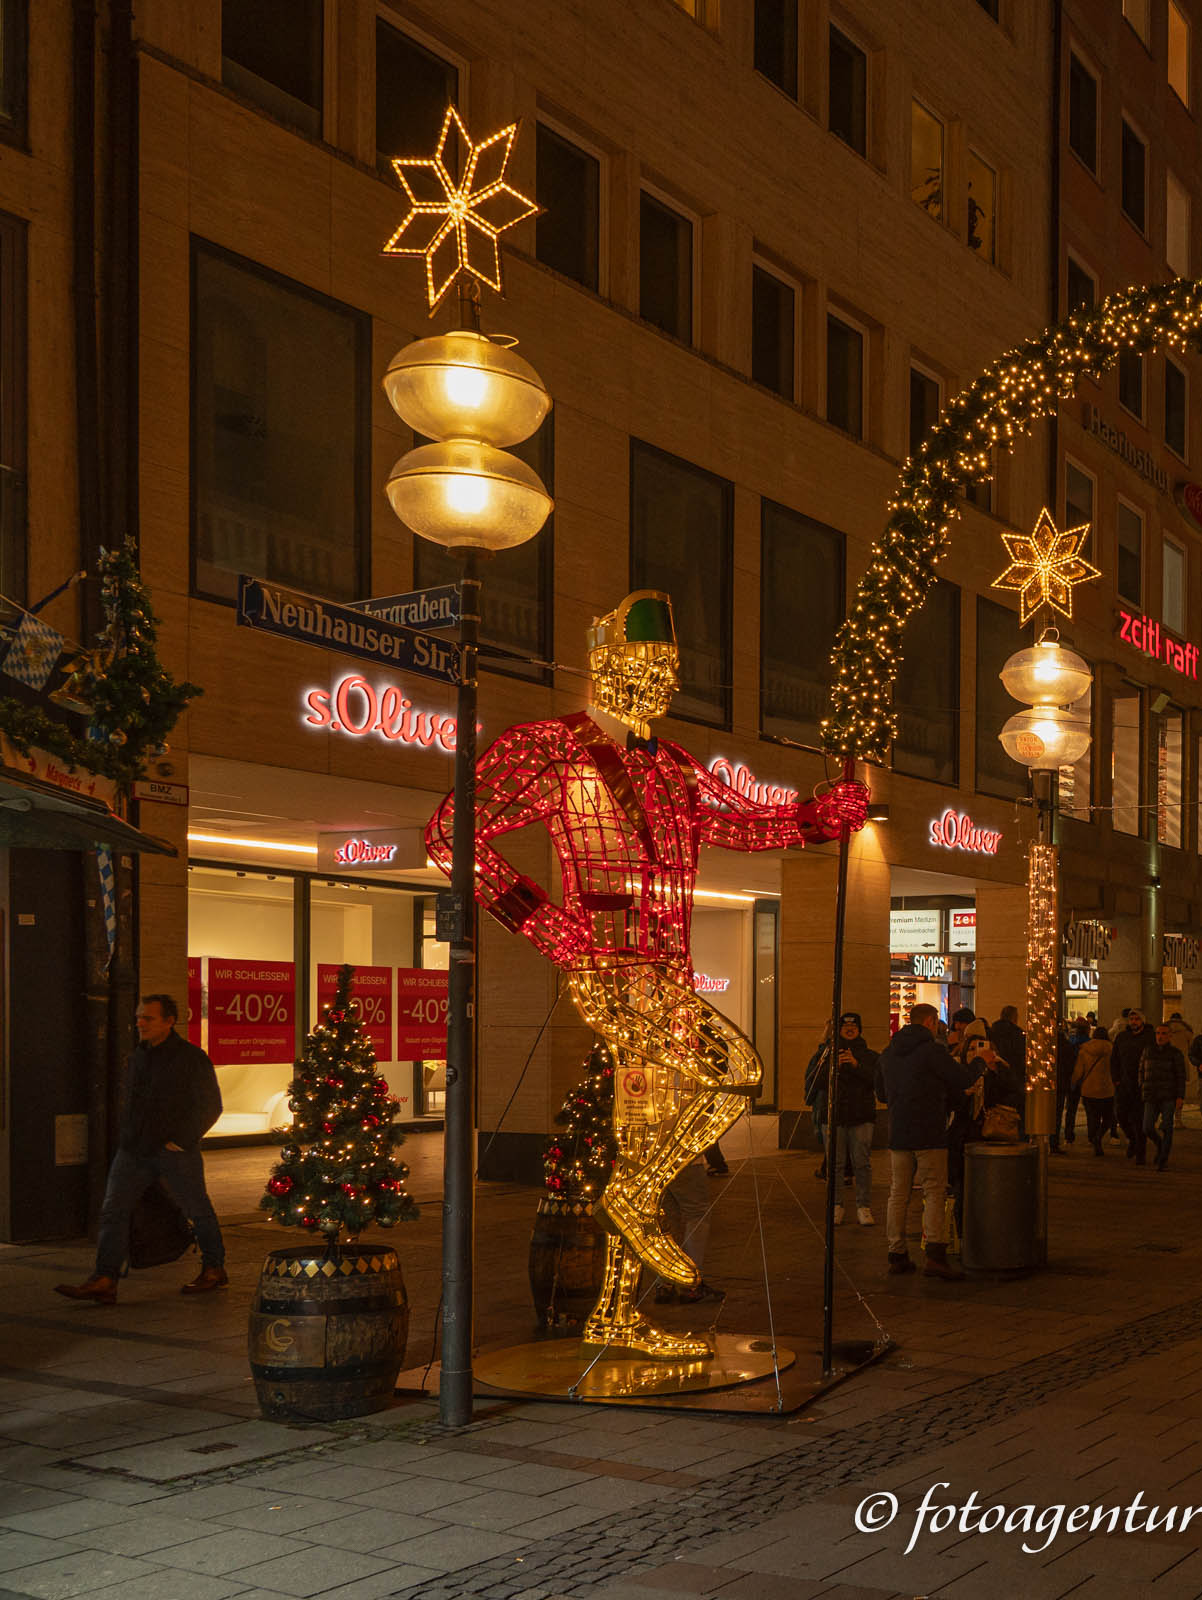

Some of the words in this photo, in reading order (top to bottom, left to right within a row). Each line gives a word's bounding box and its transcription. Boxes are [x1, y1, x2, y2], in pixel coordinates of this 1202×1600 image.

[260, 587, 406, 660] Neuhauser
[306, 675, 482, 751] s.Olive
[931, 809, 1003, 854] s.Oliver
[334, 839, 394, 863] s.Oliver
[215, 968, 233, 979] WIR
[234, 970, 290, 981] SCHLIESSEN!
[914, 955, 945, 981] snipes
[403, 978, 417, 986] WIR
[215, 993, 288, 1022] -40%
